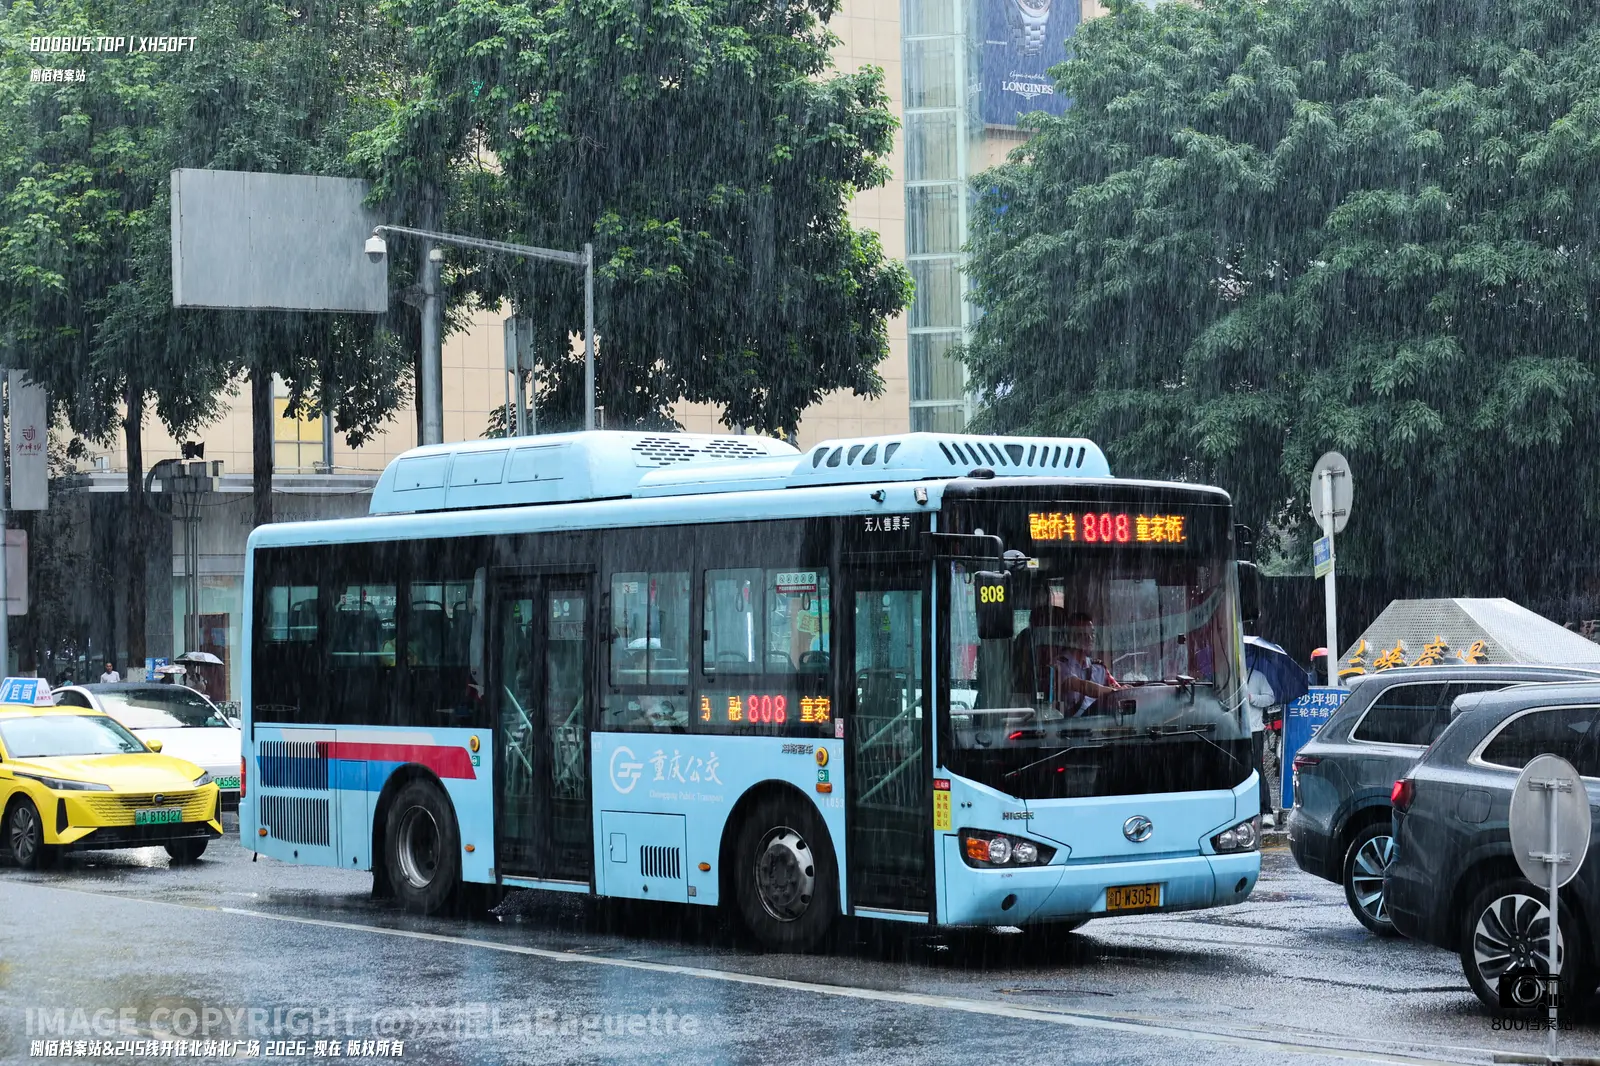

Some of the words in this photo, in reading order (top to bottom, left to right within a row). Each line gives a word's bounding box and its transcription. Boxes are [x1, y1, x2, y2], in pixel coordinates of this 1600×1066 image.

[1002, 81, 1054, 94] LONGINES
[864, 516, 910, 532] 无人售票车
[1082, 512, 1130, 542] 808
[1136, 513, 1187, 542] 童家桥
[980, 585, 1005, 603] 808
[748, 695, 787, 722] 808
[800, 695, 831, 722] 童家
[648, 749, 723, 785] 重庆公交
[1002, 811, 1035, 820] HIGER
